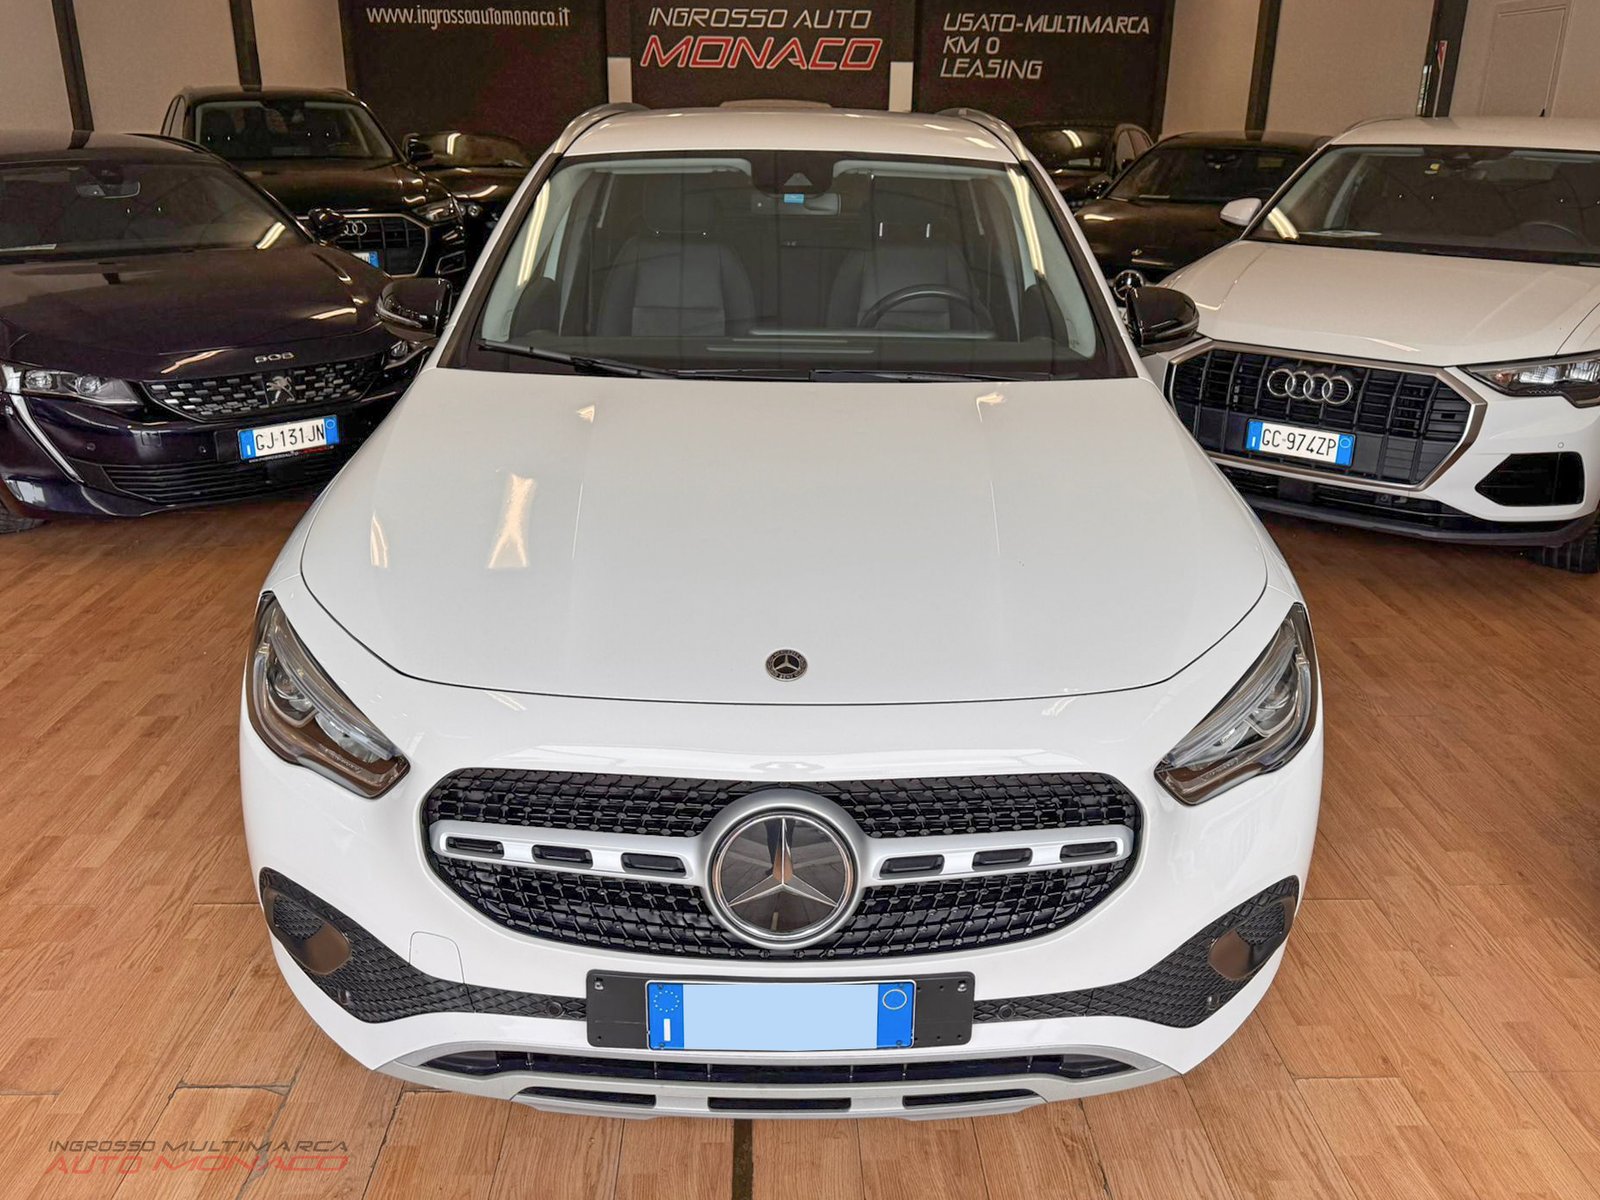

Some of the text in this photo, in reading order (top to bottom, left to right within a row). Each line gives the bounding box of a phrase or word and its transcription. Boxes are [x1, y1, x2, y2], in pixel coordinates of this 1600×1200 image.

[366, 5, 571, 31] www.ingrossoautomonaco.it
[649, 7, 872, 29] INGROSSO AUTO
[943, 13, 1150, 35] USATO-MULTIMARCA
[640, 35, 883, 70] MONACO
[943, 36, 980, 54] KM
[940, 58, 1043, 79] LEASING
